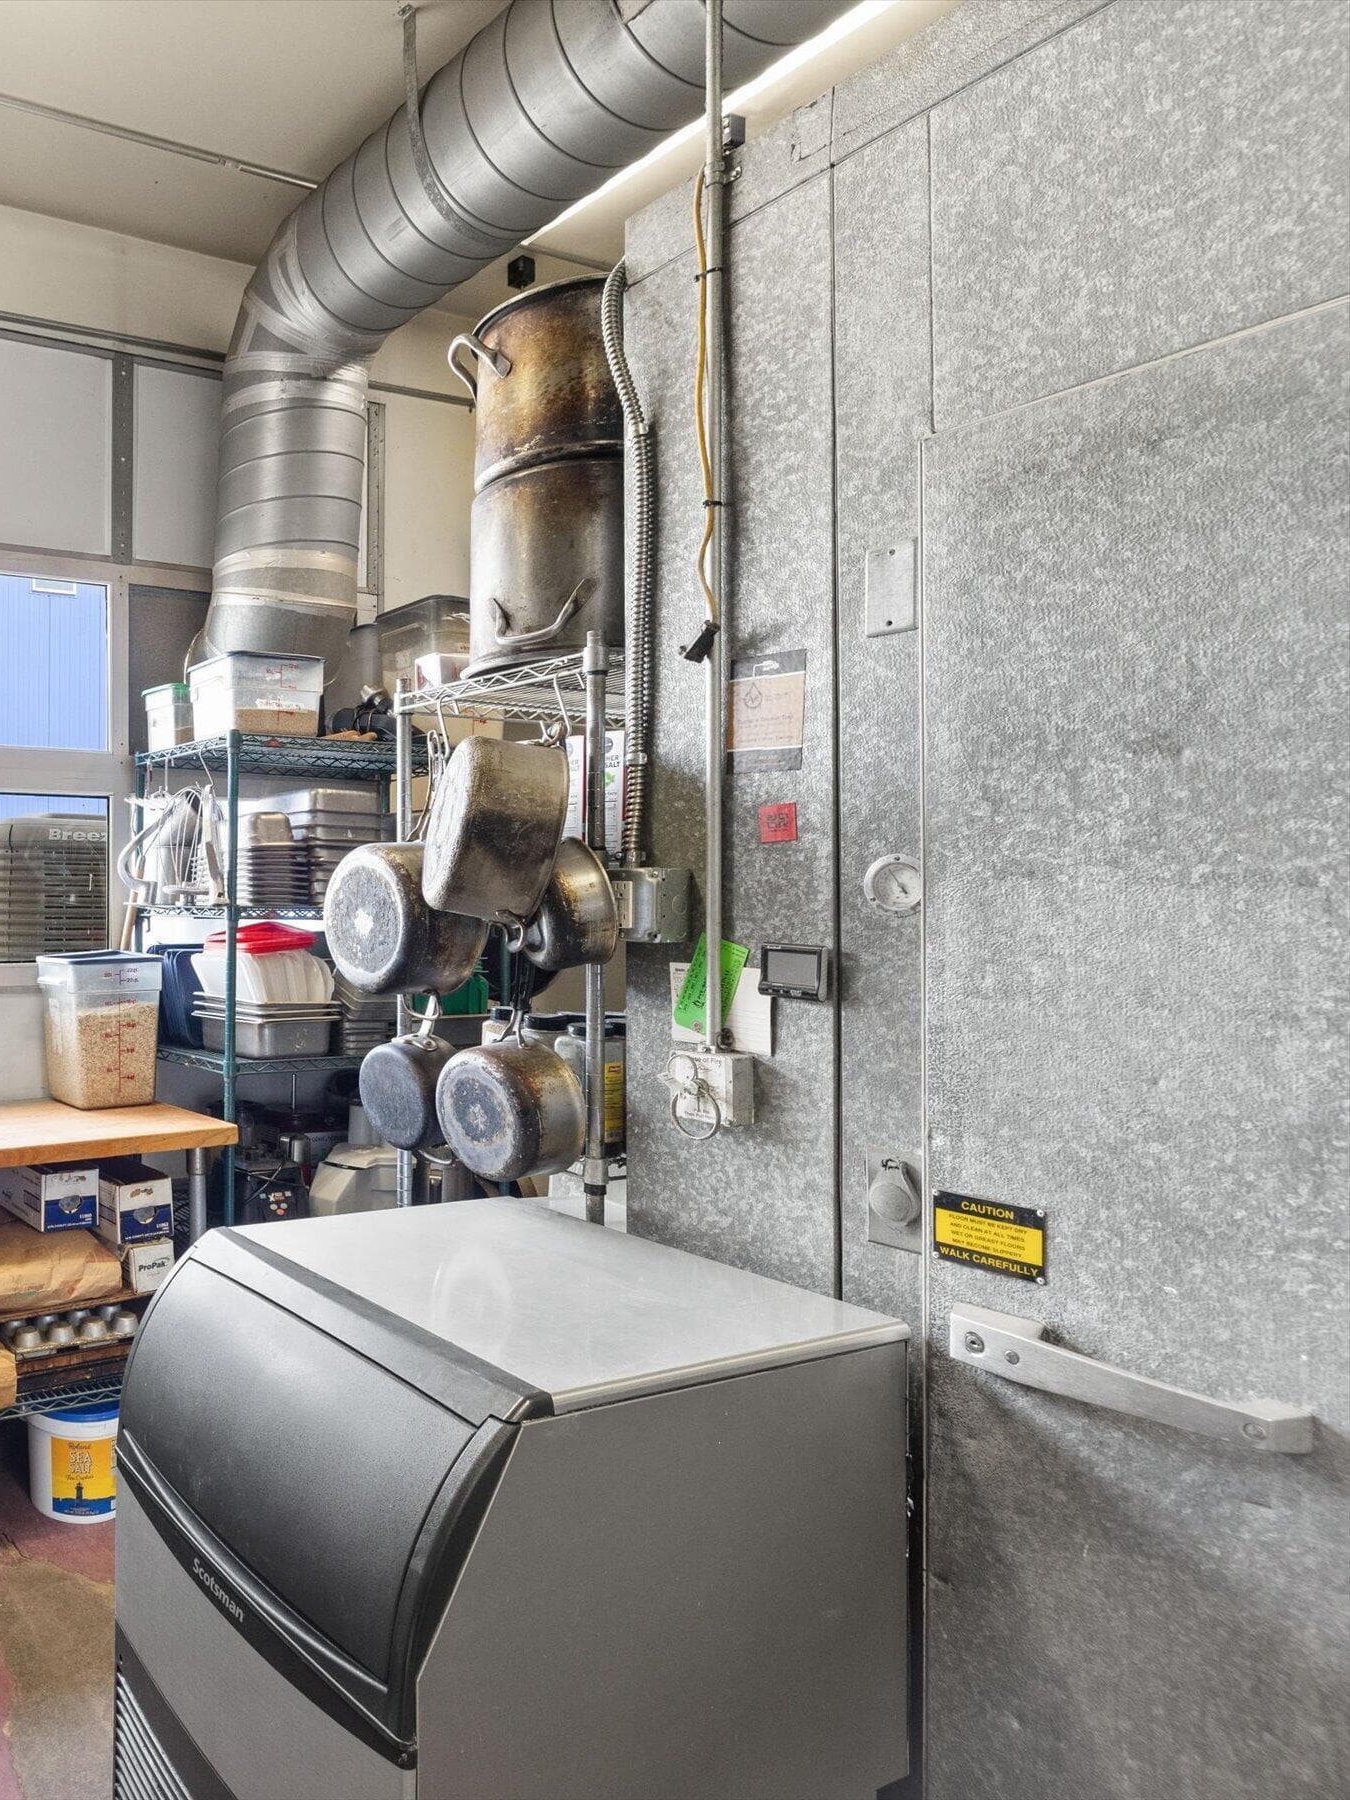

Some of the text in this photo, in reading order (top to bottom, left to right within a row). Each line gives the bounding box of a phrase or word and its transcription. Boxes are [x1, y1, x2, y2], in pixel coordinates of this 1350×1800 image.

[961, 1201, 1014, 1220] CAUTION
[949, 1213, 969, 1222] FLOOR
[969, 1217, 986, 1226] MUST
[996, 1223, 1013, 1231] KEPT
[1014, 1227, 1027, 1235] DRY
[963, 1224, 983, 1233] CLEAN
[966, 1241, 991, 1251] BECOME
[975, 1235, 999, 1246] GREASY
[1000, 1240, 1026, 1251] FLOORS
[138, 1260, 166, 1272] ProPak
[939, 1246, 1039, 1277] WALK CAREFULLY
[69, 1451, 92, 1463] SEA
[69, 1463, 92, 1474] SALT
[192, 1557, 244, 1623] Scotsman
